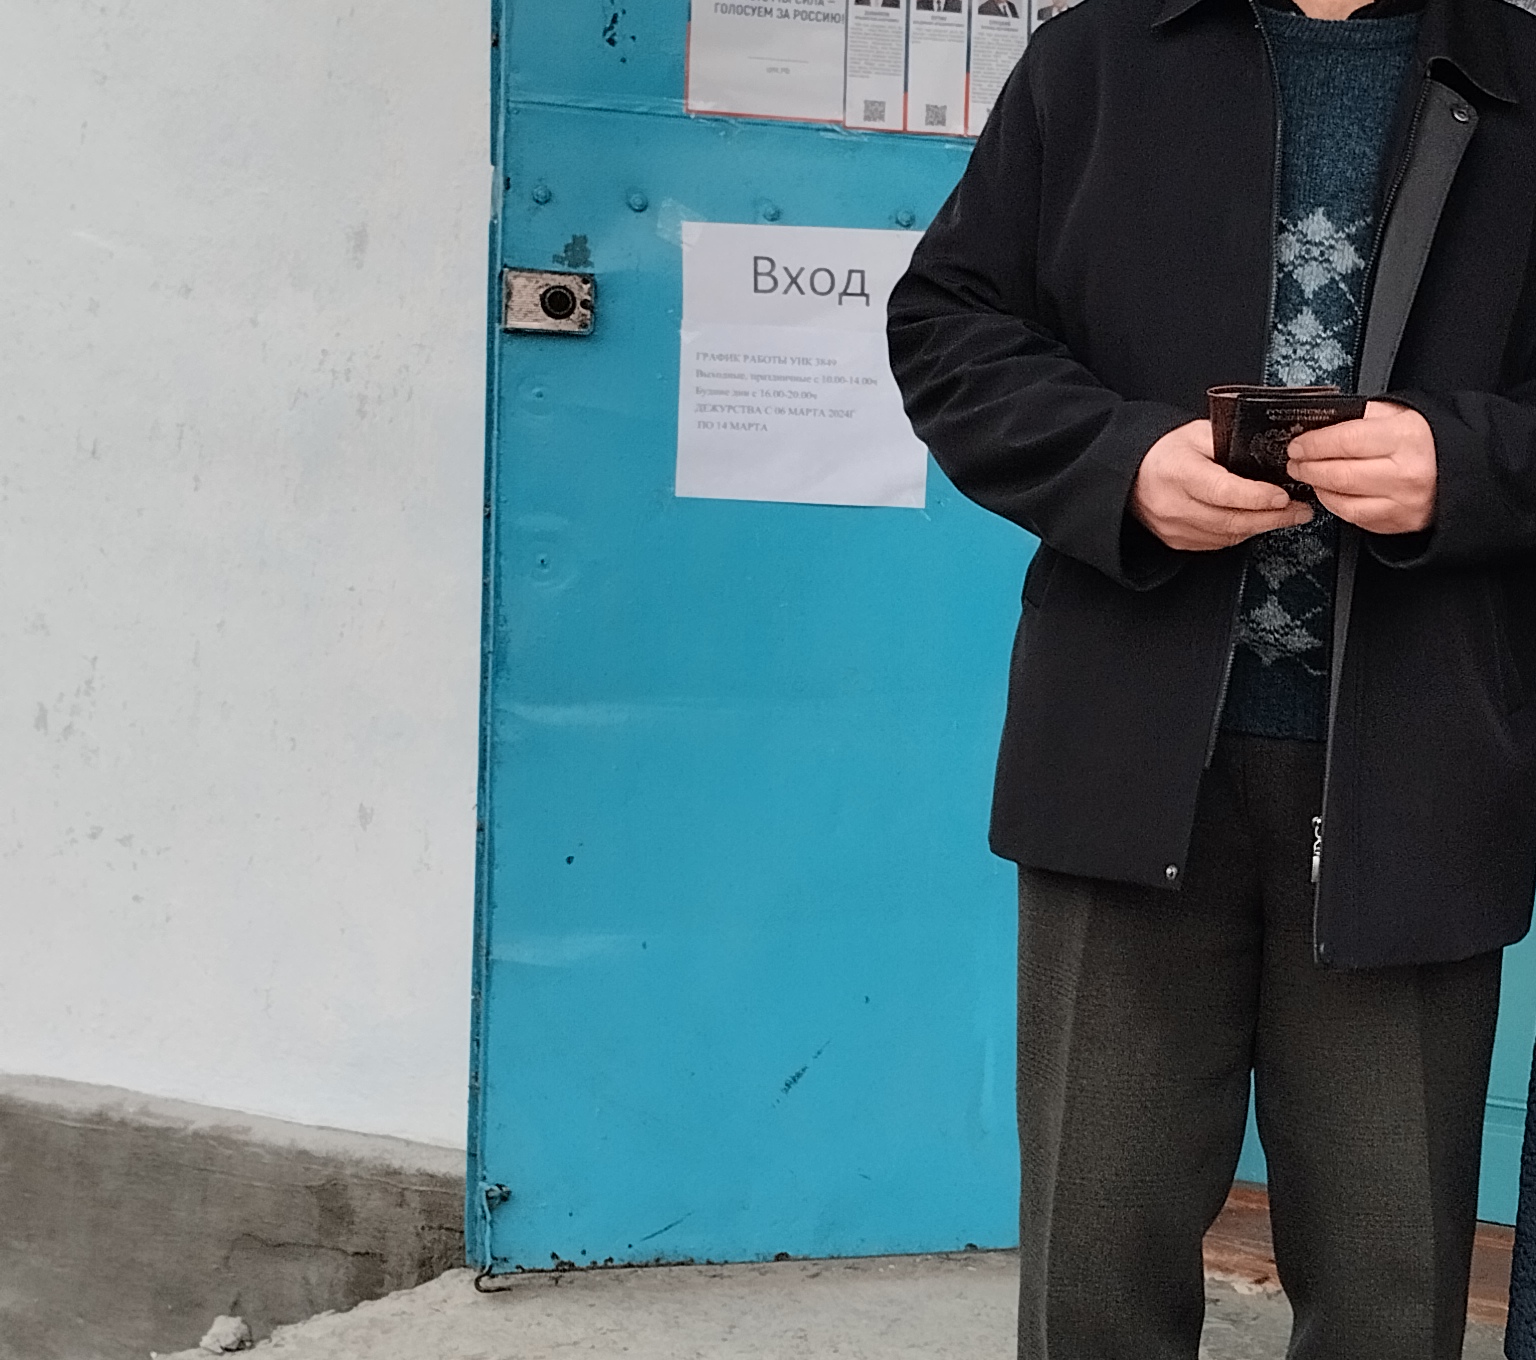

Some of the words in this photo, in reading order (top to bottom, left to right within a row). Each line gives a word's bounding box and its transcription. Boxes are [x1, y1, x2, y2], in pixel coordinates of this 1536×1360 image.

[713, 2, 774, 19] ГОЛОСУЕМ
[776, 7, 791, 20] ЗА
[792, 9, 845, 24] РОССИЮ!
[752, 255, 871, 307] Вход
[695, 352, 741, 363] ГРАФИК
[743, 354, 788, 366] РАБОТЫ
[694, 403, 763, 415] ДЕЖУРСТВА
[788, 407, 826, 418] МАРТА
[697, 420, 714, 431] ПО
[716, 421, 728, 430] 14
[729, 421, 769, 432] МАРТА
